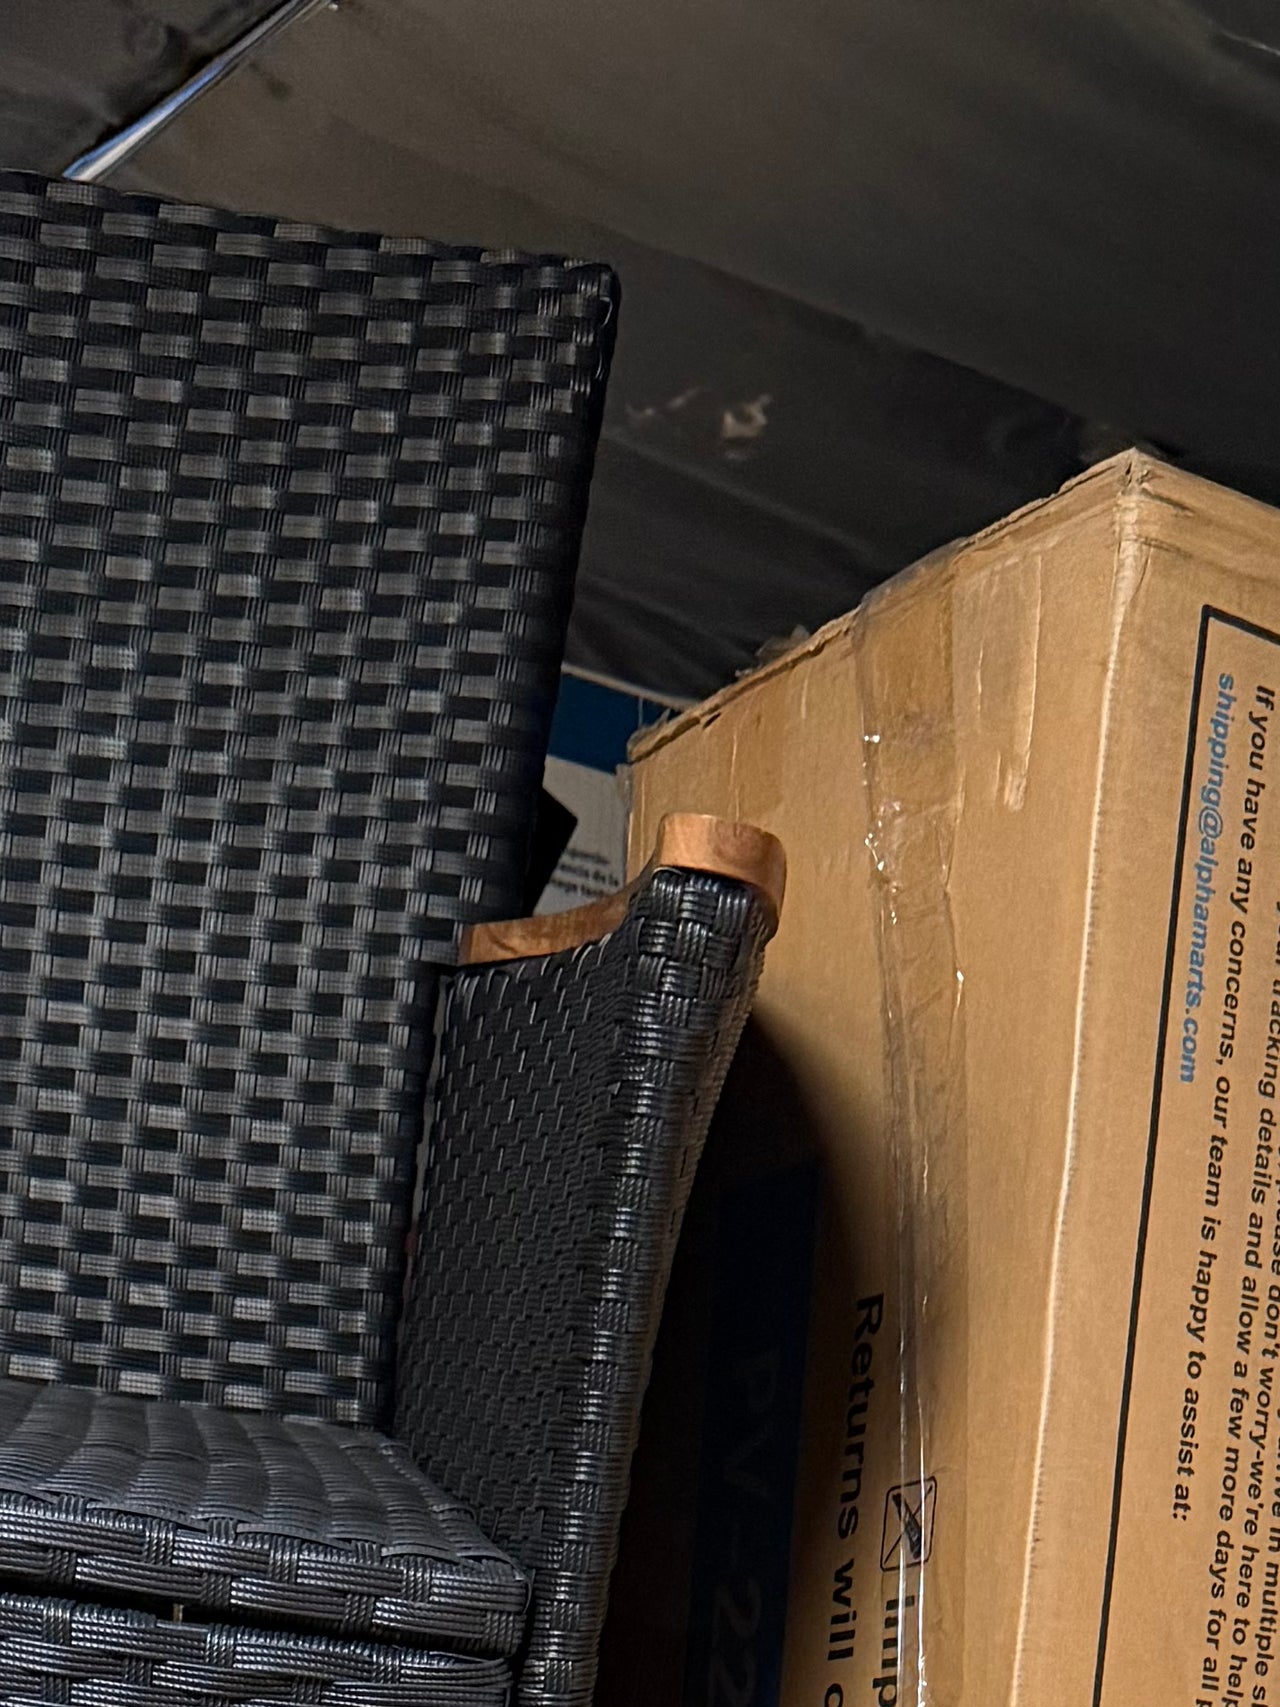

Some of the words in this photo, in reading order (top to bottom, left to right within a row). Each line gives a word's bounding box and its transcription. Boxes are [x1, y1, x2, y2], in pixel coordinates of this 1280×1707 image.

[1254, 684, 1276, 712] If
[1248, 709, 1269, 771] you
[1239, 777, 1266, 851] have
[1178, 673, 1236, 1084] shipping@alphamarts.com
[1229, 856, 1253, 915] any
[1214, 919, 1246, 1066] concerns,
[1212, 1075, 1231, 1130] our
[1203, 1133, 1228, 1207] team
[1199, 1214, 1222, 1241] is
[1185, 1248, 1218, 1343] happy
[1185, 1349, 1207, 1380] to
[836, 1292, 884, 1541] Returns
[1175, 1386, 1200, 1477] assist
[1242, 1366, 1274, 1536] worry-we're
[1171, 1482, 1192, 1522] at:
[824, 1558, 860, 1662] will
[1235, 1543, 1261, 1609] here
[1231, 1616, 1251, 1646] to
[1253, 1560, 1280, 1677] multiple
